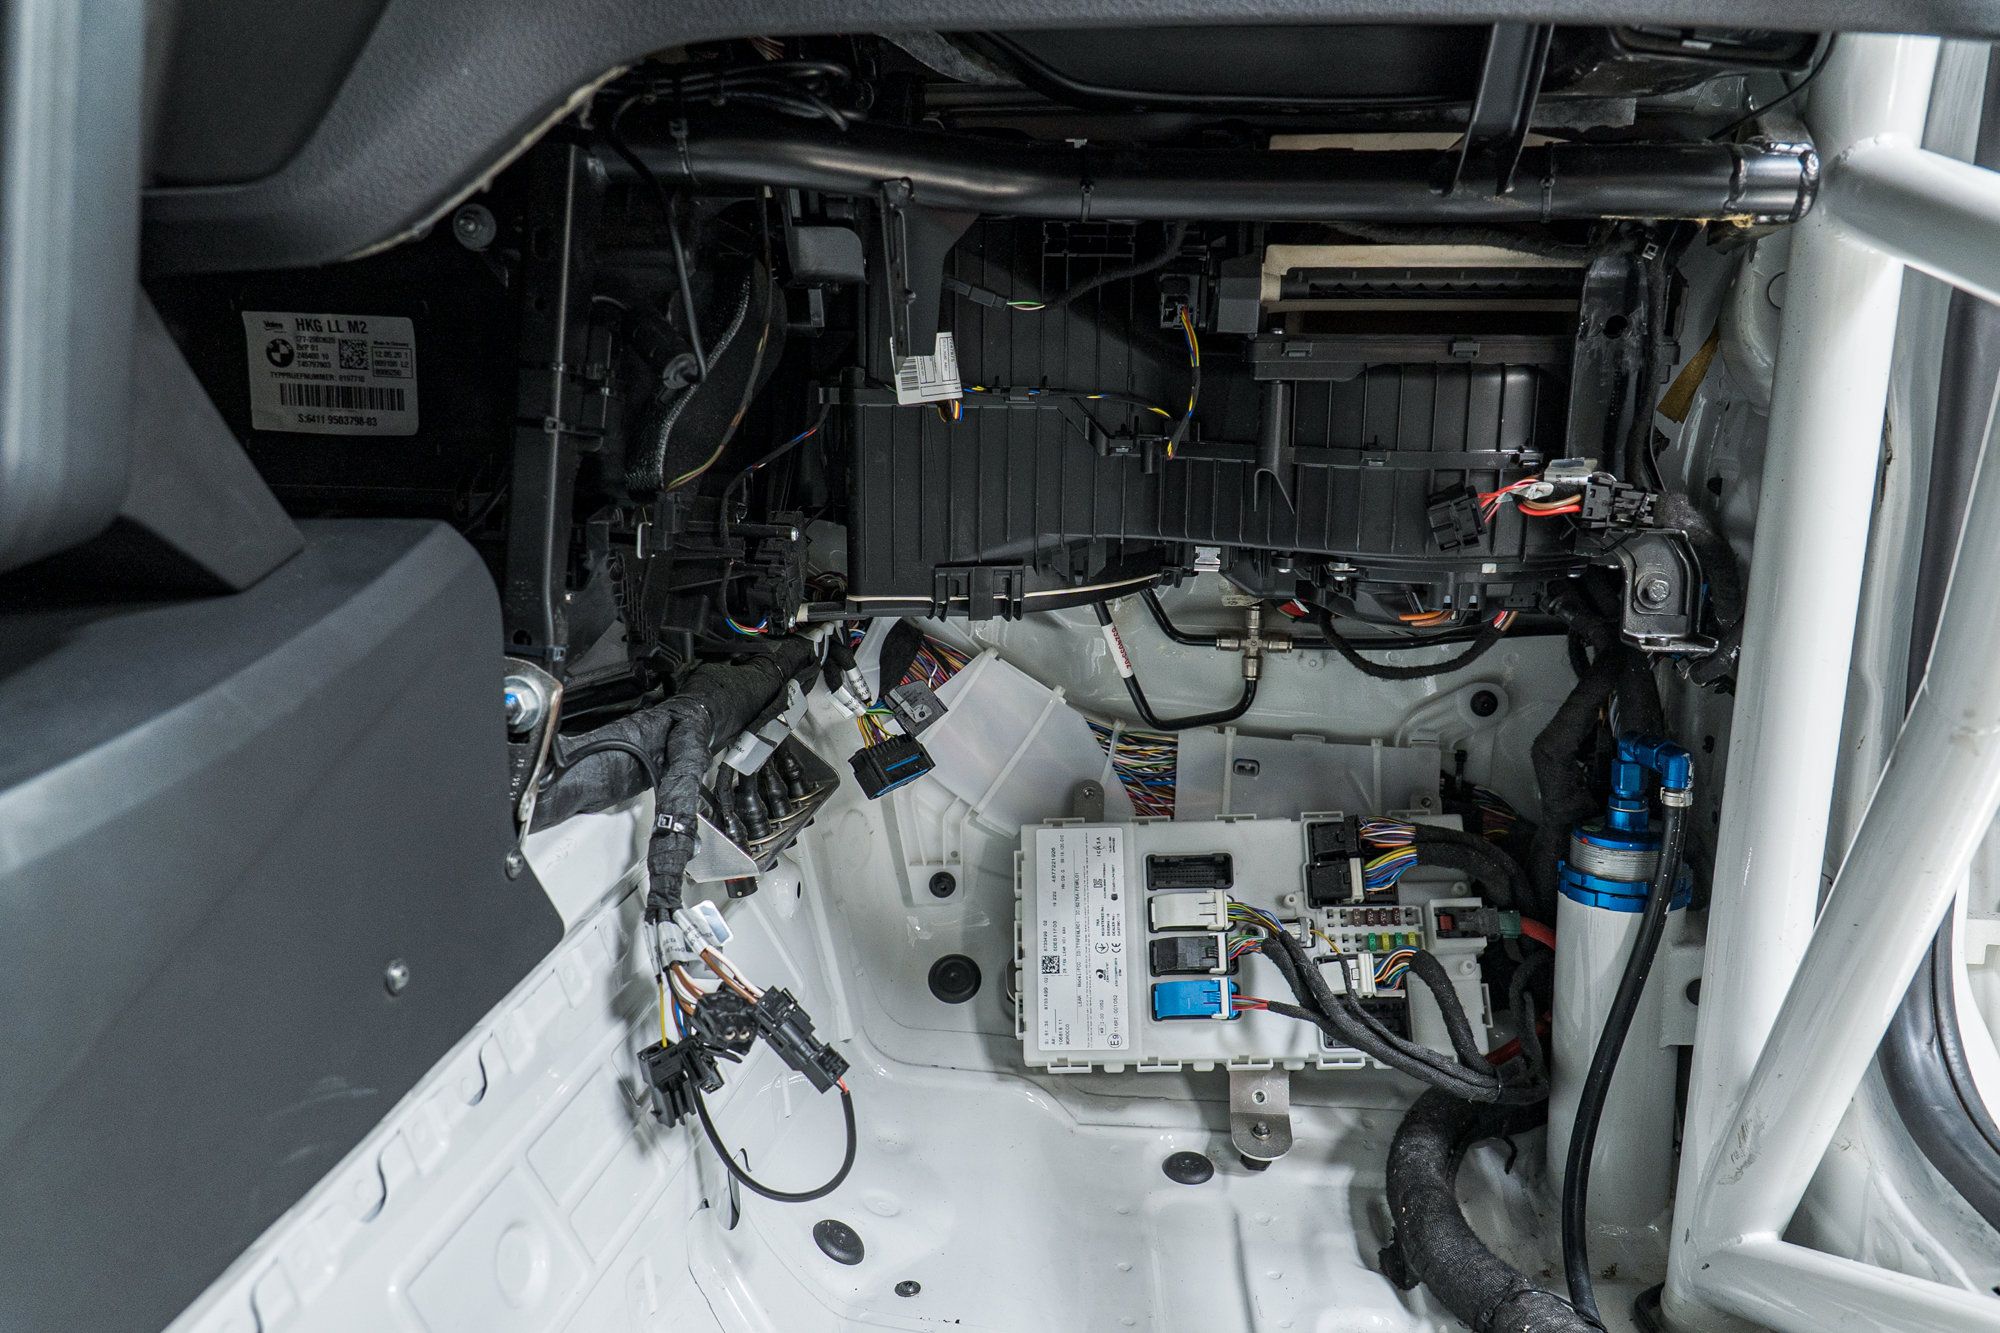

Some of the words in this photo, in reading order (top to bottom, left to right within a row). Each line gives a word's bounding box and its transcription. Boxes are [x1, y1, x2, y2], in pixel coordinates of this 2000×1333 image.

[295, 318, 323, 332] HKG
[328, 321, 344, 333] LL
[348, 321, 368, 334] M2
